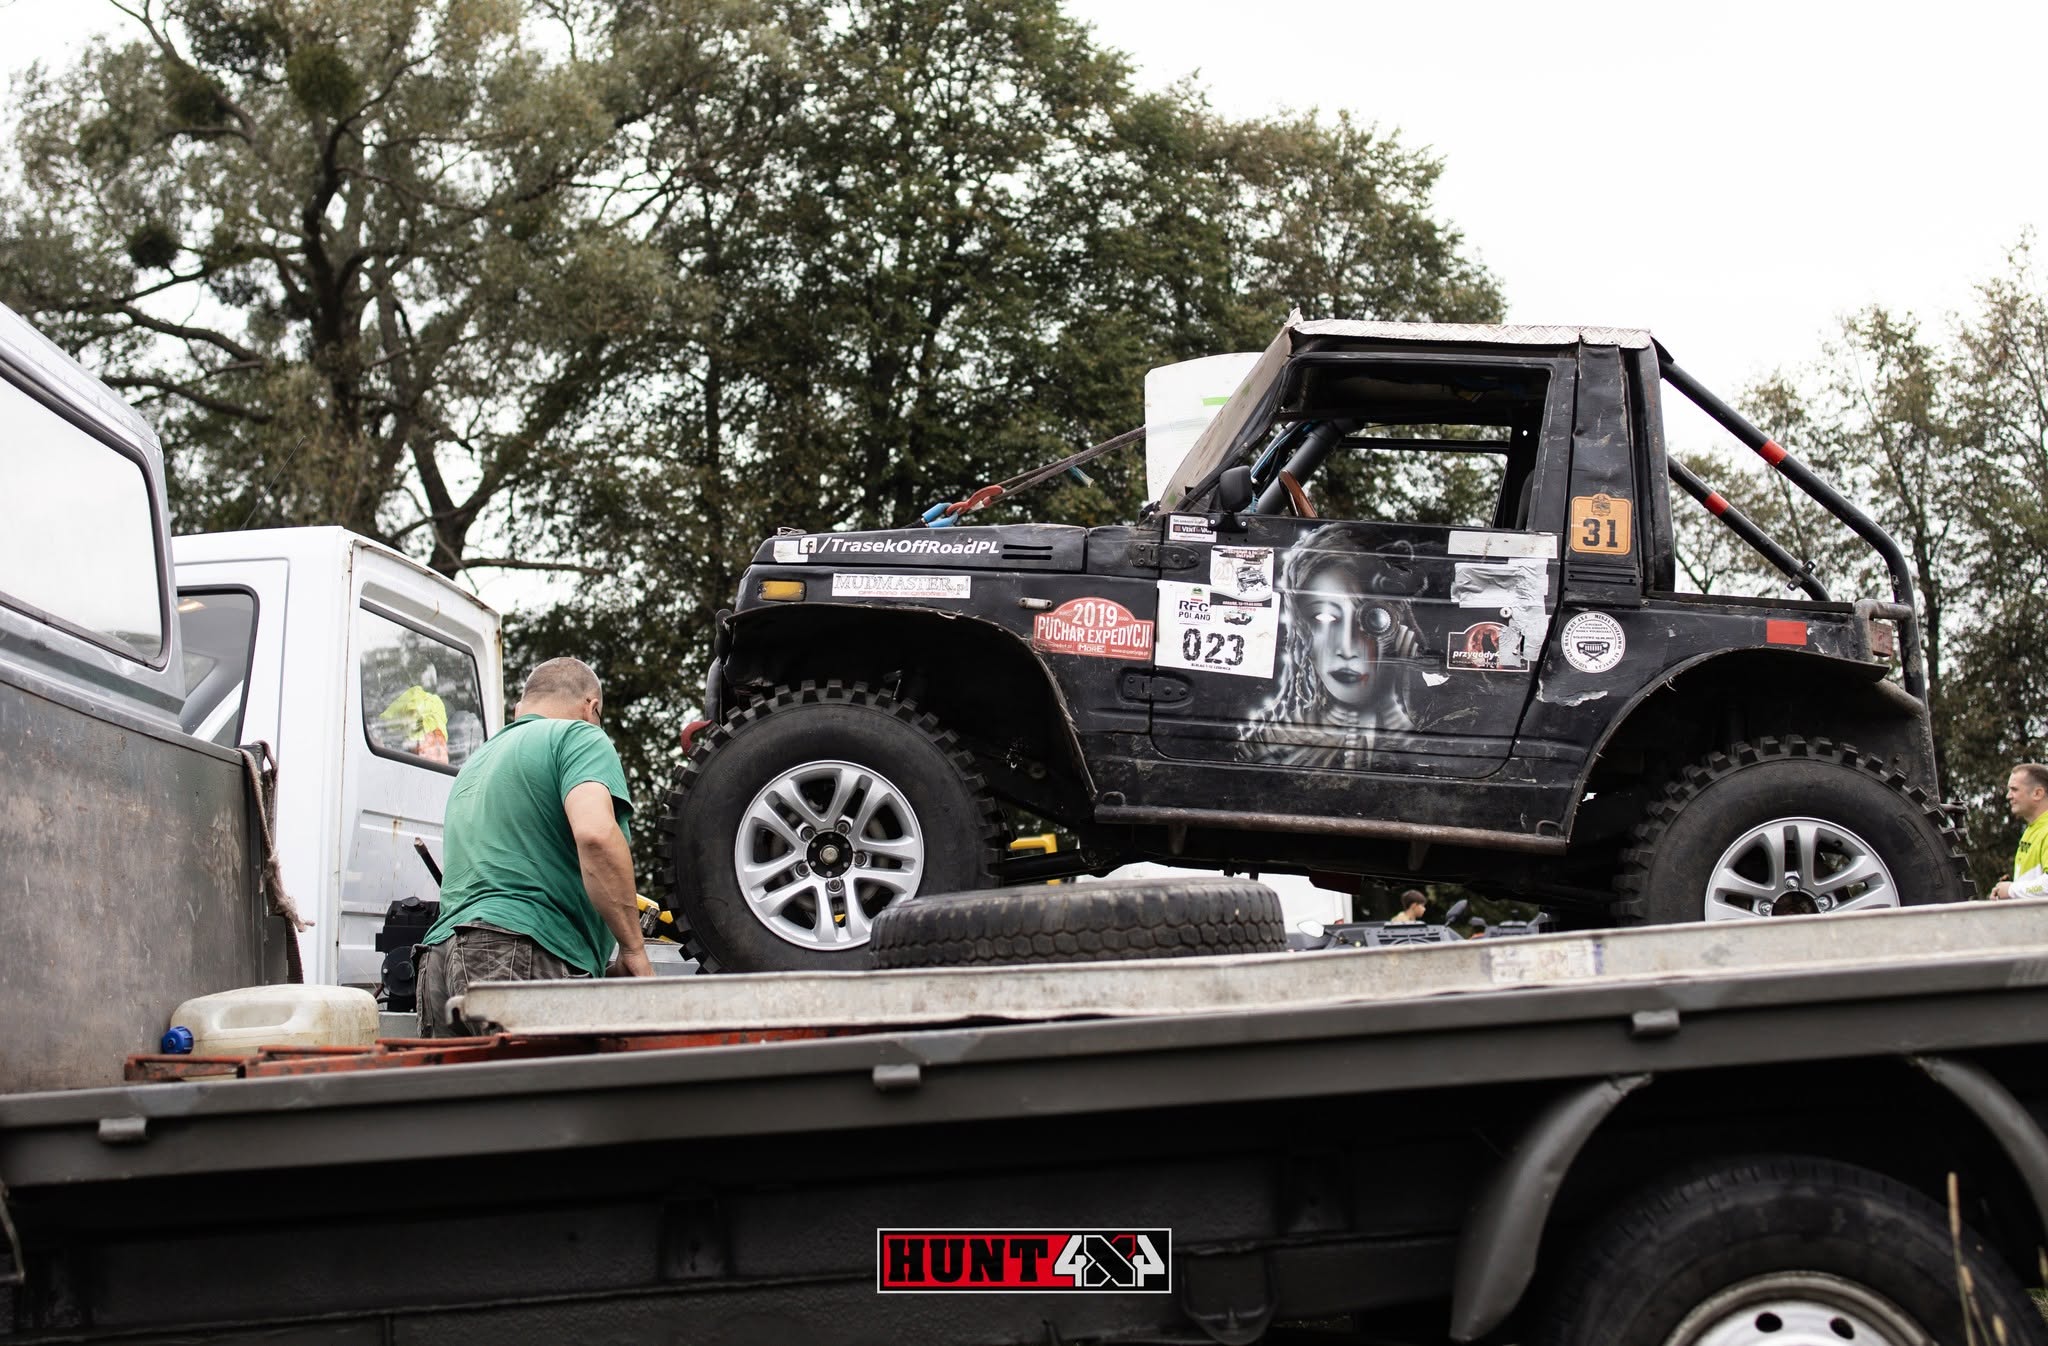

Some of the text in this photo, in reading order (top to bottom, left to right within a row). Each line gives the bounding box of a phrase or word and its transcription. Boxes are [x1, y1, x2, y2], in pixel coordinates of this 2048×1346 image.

[1582, 518, 1618, 548] 31
[818, 536, 1000, 554] /TrasekOffRoadPL
[834, 574, 969, 595] MUDMASTER.pl
[1071, 602, 1118, 628] 2019
[1177, 611, 1211, 622] POLAND
[1178, 600, 1209, 613] RFC
[1037, 615, 1151, 648] PUCHAR EXPEDYCJI
[1182, 628, 1245, 666] 023
